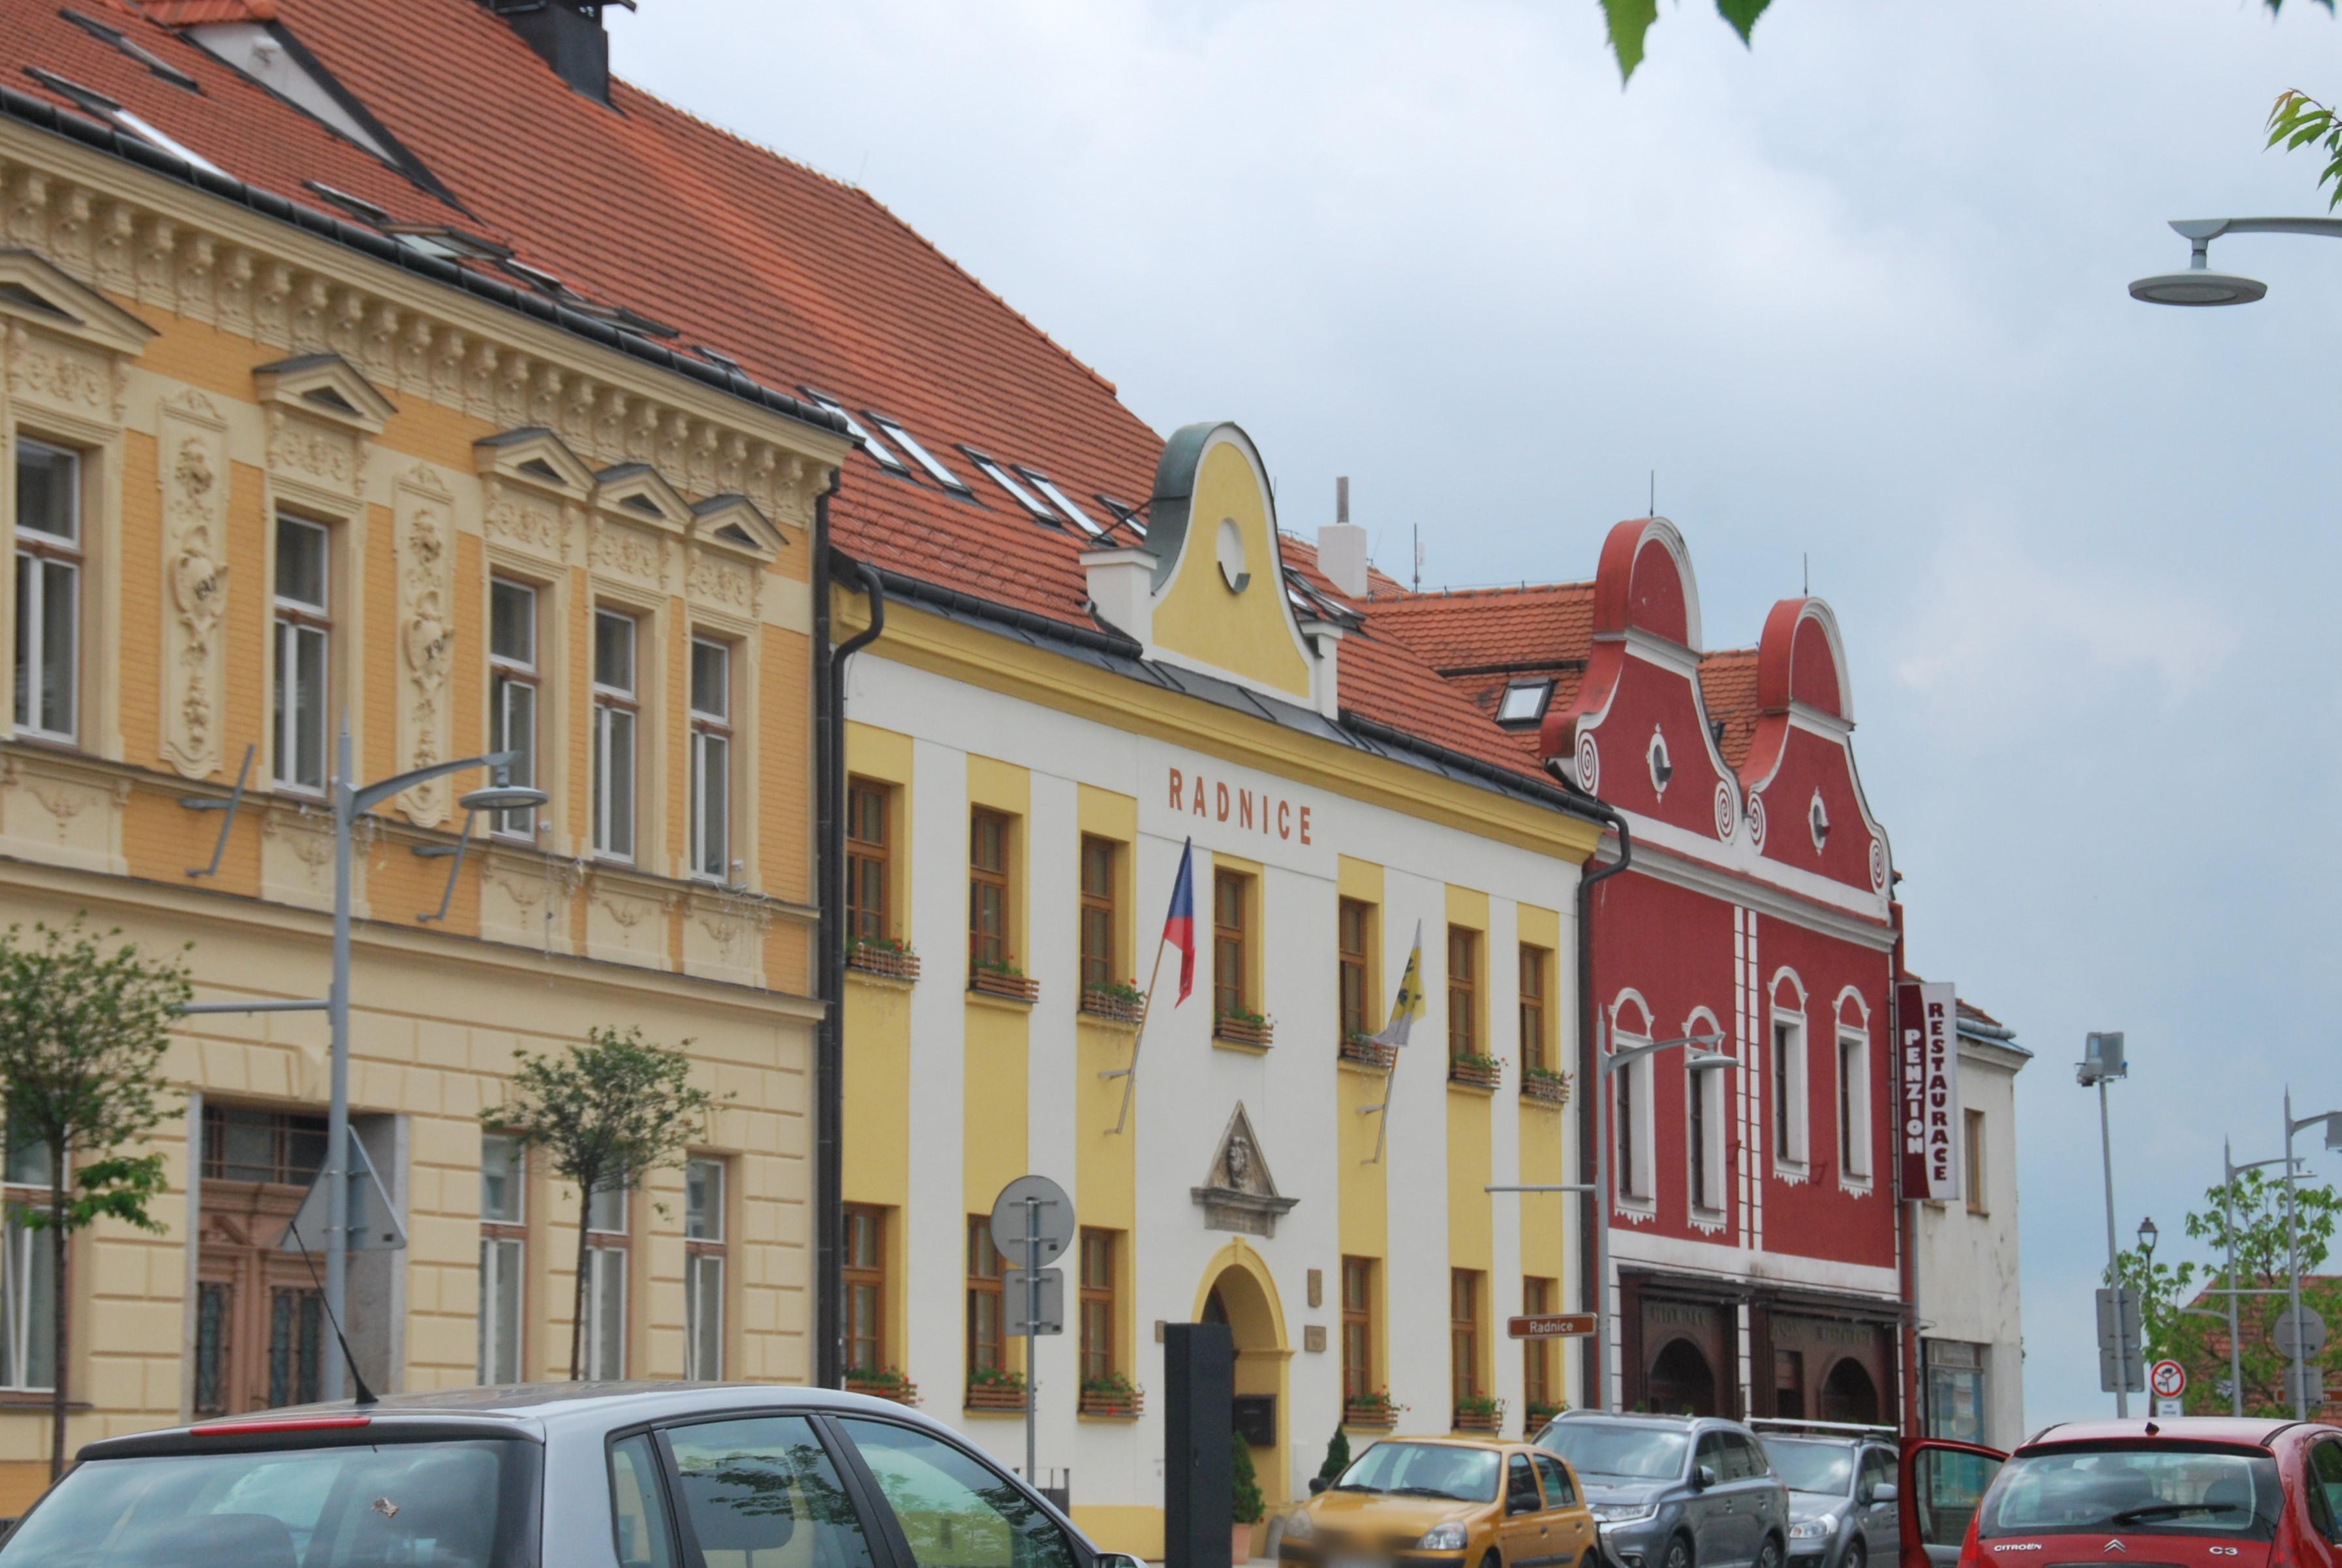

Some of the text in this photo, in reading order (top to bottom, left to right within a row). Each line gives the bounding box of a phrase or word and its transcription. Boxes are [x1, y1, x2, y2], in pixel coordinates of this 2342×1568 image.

[1169, 767, 1311, 846] RADNICE
[1904, 1029, 1924, 1154] PENZION
[1928, 1003, 1949, 1181] RESTAURACE
[1530, 1320, 1573, 1334] Radnice
[1994, 1543, 2042, 1552] CITROËN
[2209, 1546, 2238, 1556] C3
